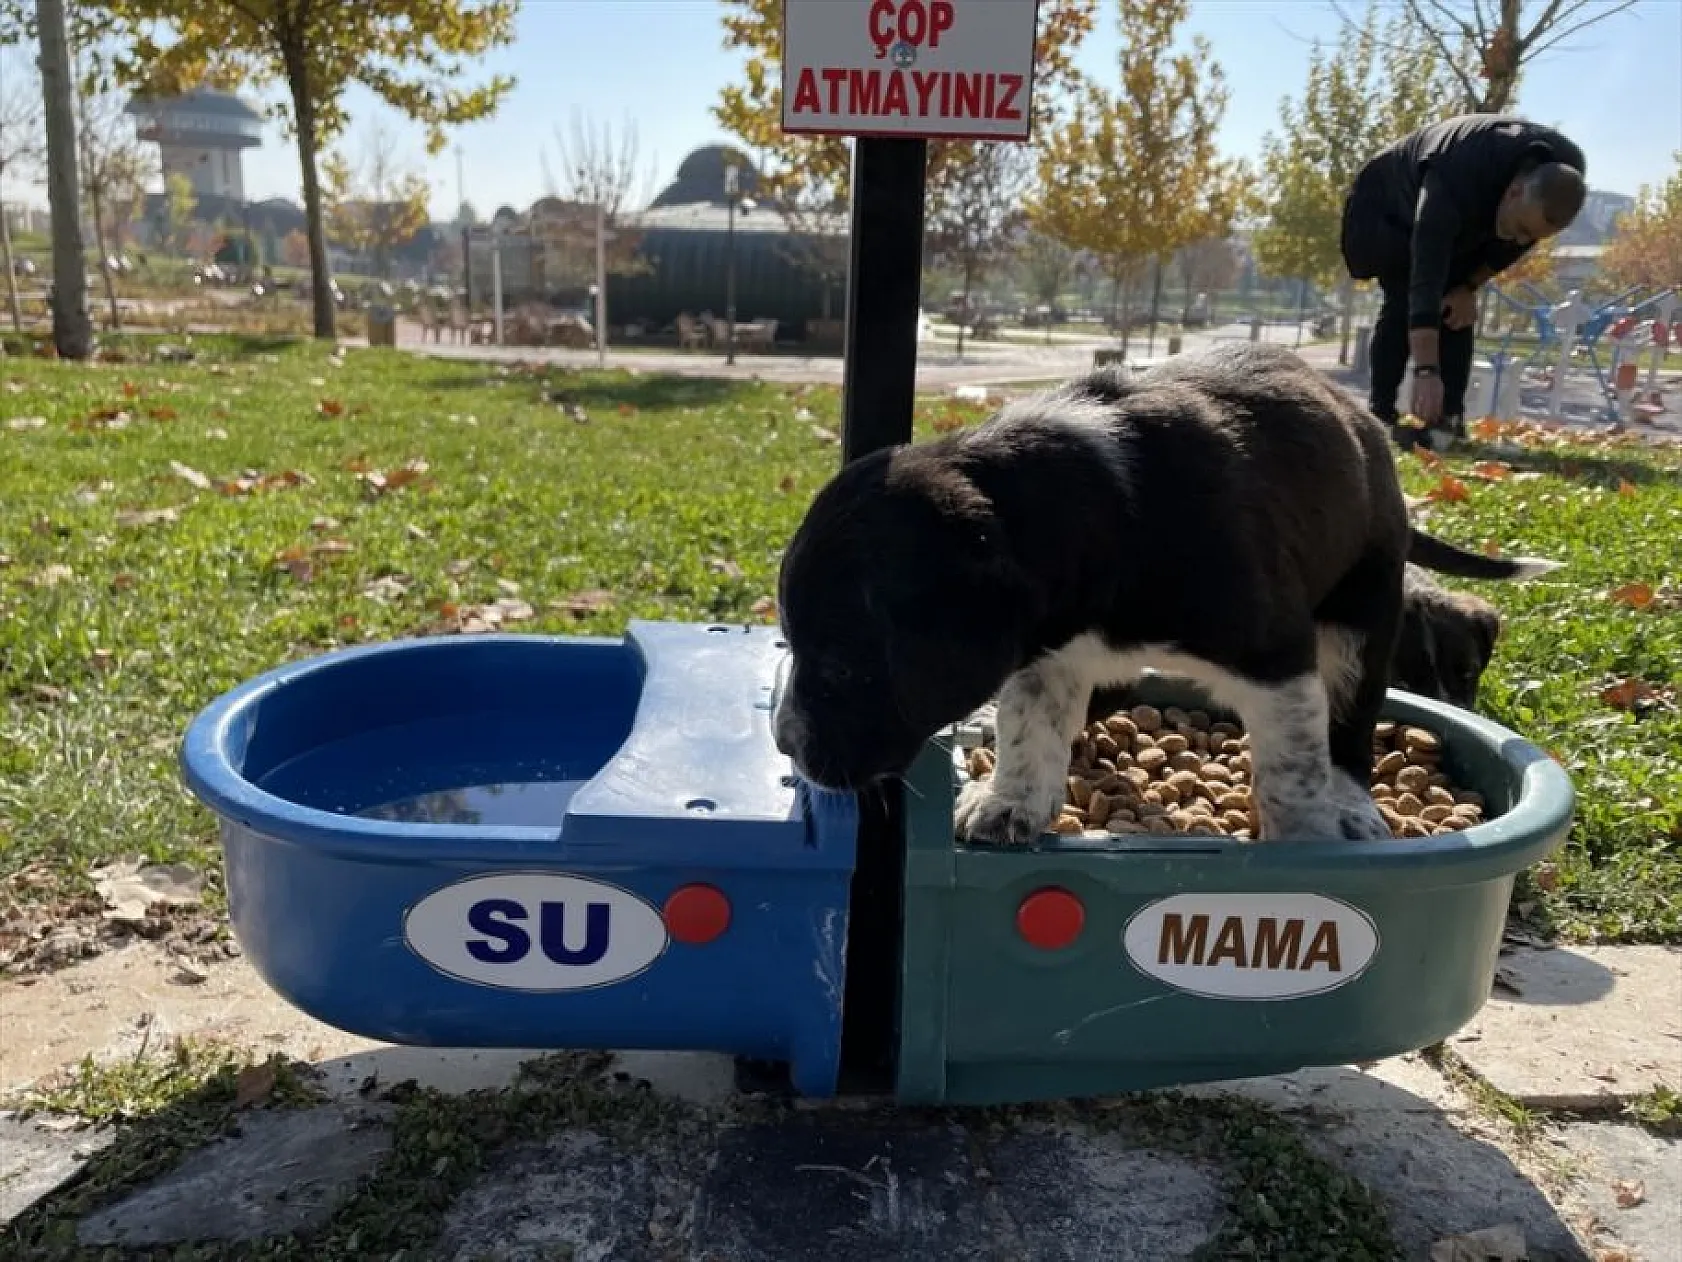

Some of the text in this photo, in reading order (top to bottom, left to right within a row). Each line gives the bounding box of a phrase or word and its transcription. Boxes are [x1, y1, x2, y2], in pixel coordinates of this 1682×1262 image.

[792, 67, 1024, 120] ATMAYINIZ
[465, 898, 611, 966] SU
[1157, 913, 1341, 972] MAMA
